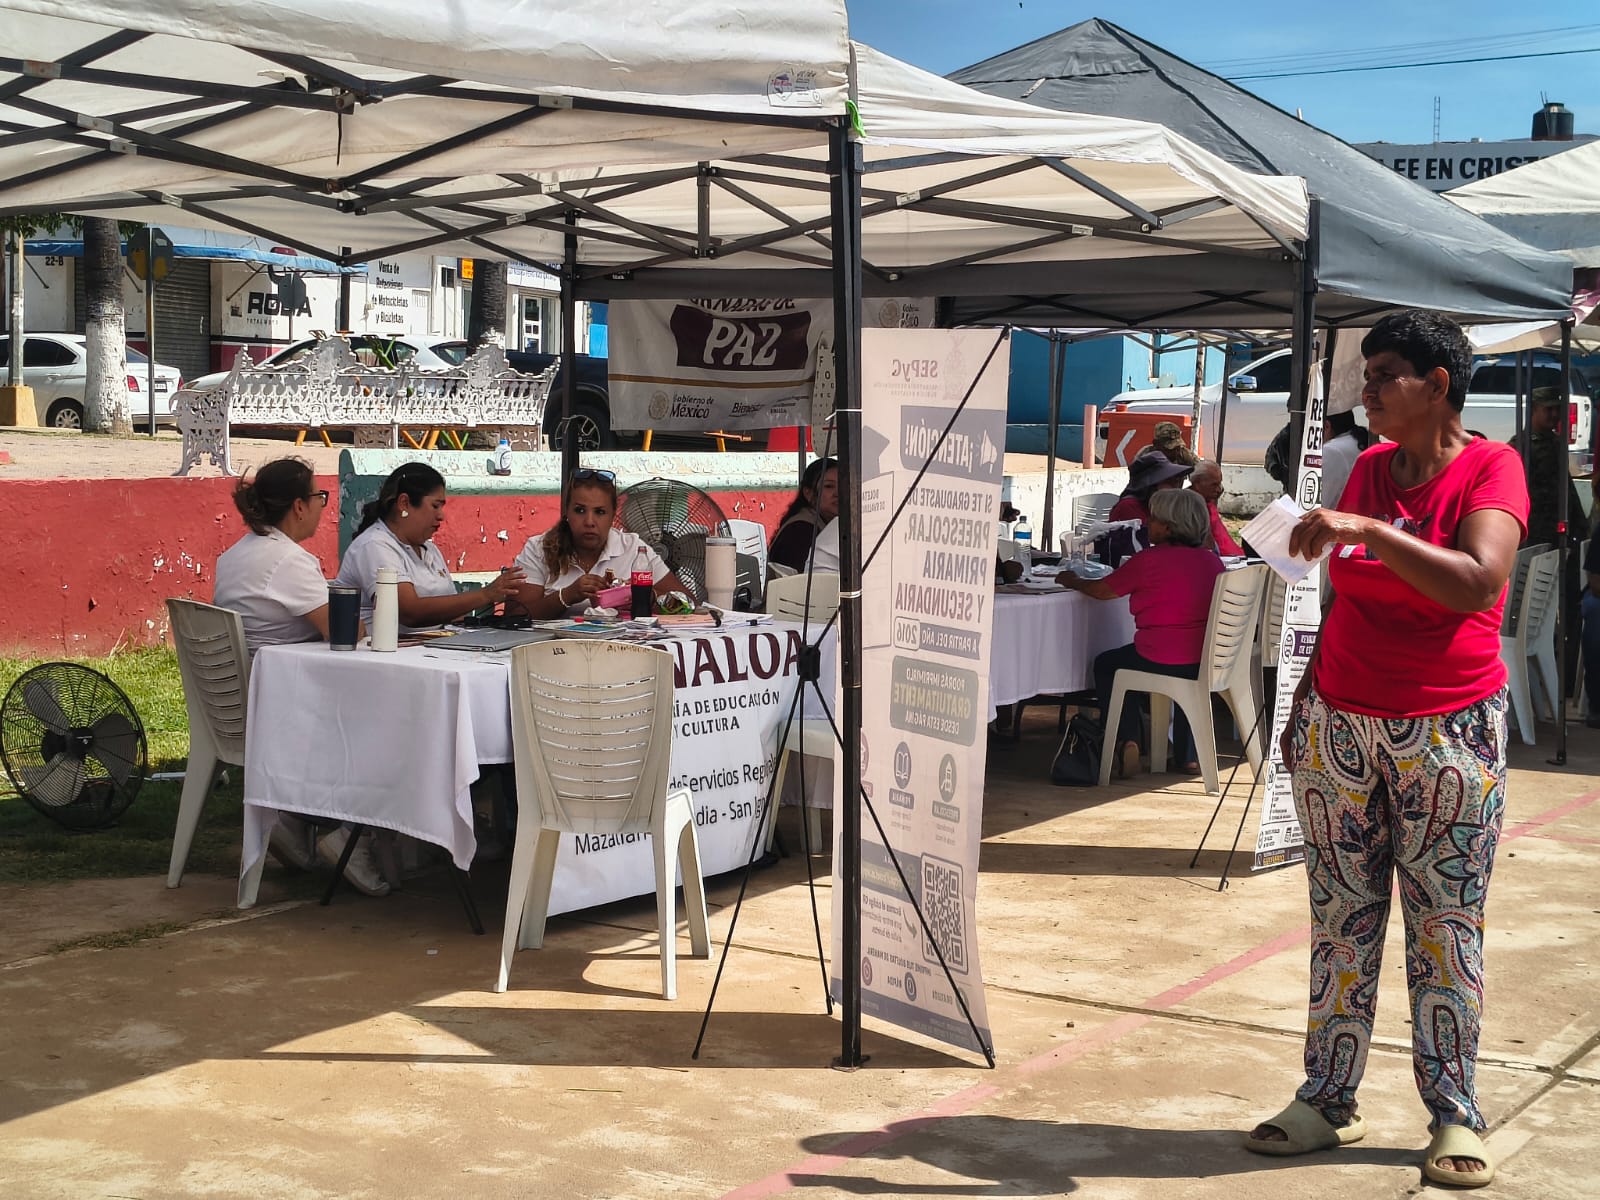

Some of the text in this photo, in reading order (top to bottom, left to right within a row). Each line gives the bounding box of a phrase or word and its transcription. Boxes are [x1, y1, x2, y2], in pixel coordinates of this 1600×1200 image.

[1425, 158, 1453, 180] EN
[45, 256, 64, 266] 22-B
[378, 260, 400, 274] Venta de
[703, 318, 782, 366] PAZ
[670, 404, 710, 419] México
[695, 700, 711, 715] DE
[713, 688, 780, 712] EDUCACIÓN
[681, 716, 740, 738] CULTURA
[696, 806, 718, 827] dia
[729, 800, 752, 821] San
